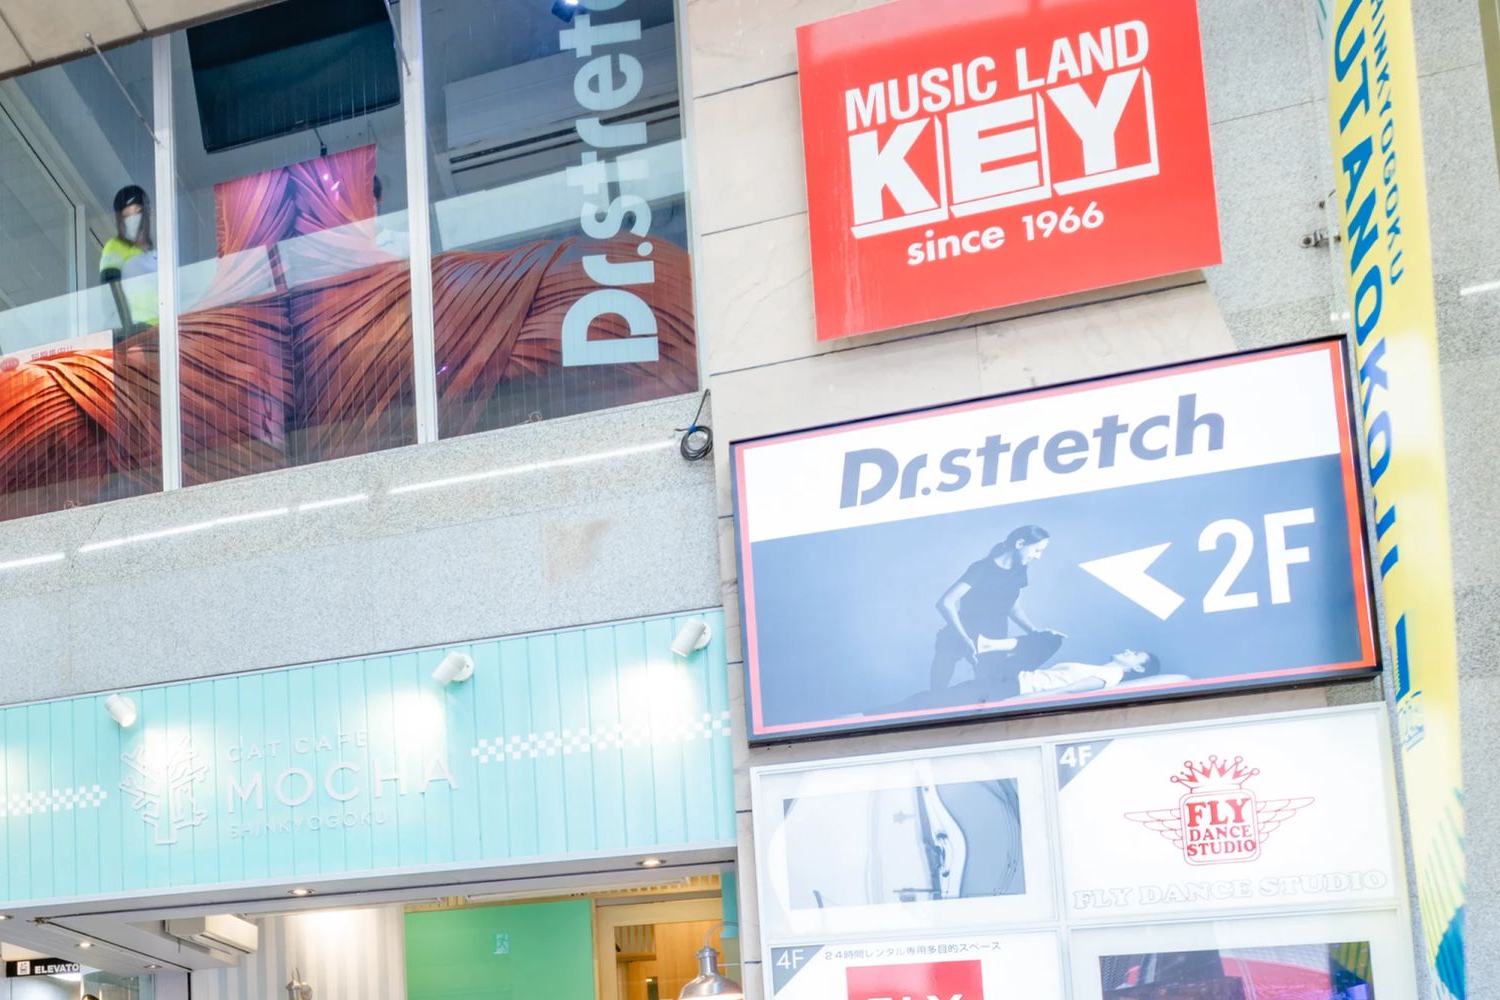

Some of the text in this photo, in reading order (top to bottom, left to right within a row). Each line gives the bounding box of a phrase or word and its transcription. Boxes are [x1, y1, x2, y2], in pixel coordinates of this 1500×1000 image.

[845, 20, 1150, 131] MUSIC LAND
[849, 67, 1160, 240] KEY
[906, 201, 1105, 266] since 1966
[838, 392, 1226, 510] Dr.stretch
[1198, 507, 1317, 613] 2F
[227, 730, 368, 763] CAT CAFE
[1059, 744, 1092, 768] 4F
[226, 757, 460, 814] MOCHA
[229, 810, 388, 840] SHINKYOGOKU
[1186, 797, 1252, 828] FLY
[1186, 838, 1257, 857] STUDIO
[1189, 824, 1253, 842] DANCE
[1073, 869, 1388, 911] FLY DANCE STUDIO
[34, 963, 82, 975] ELEVATO
[776, 949, 805, 970] 4F
